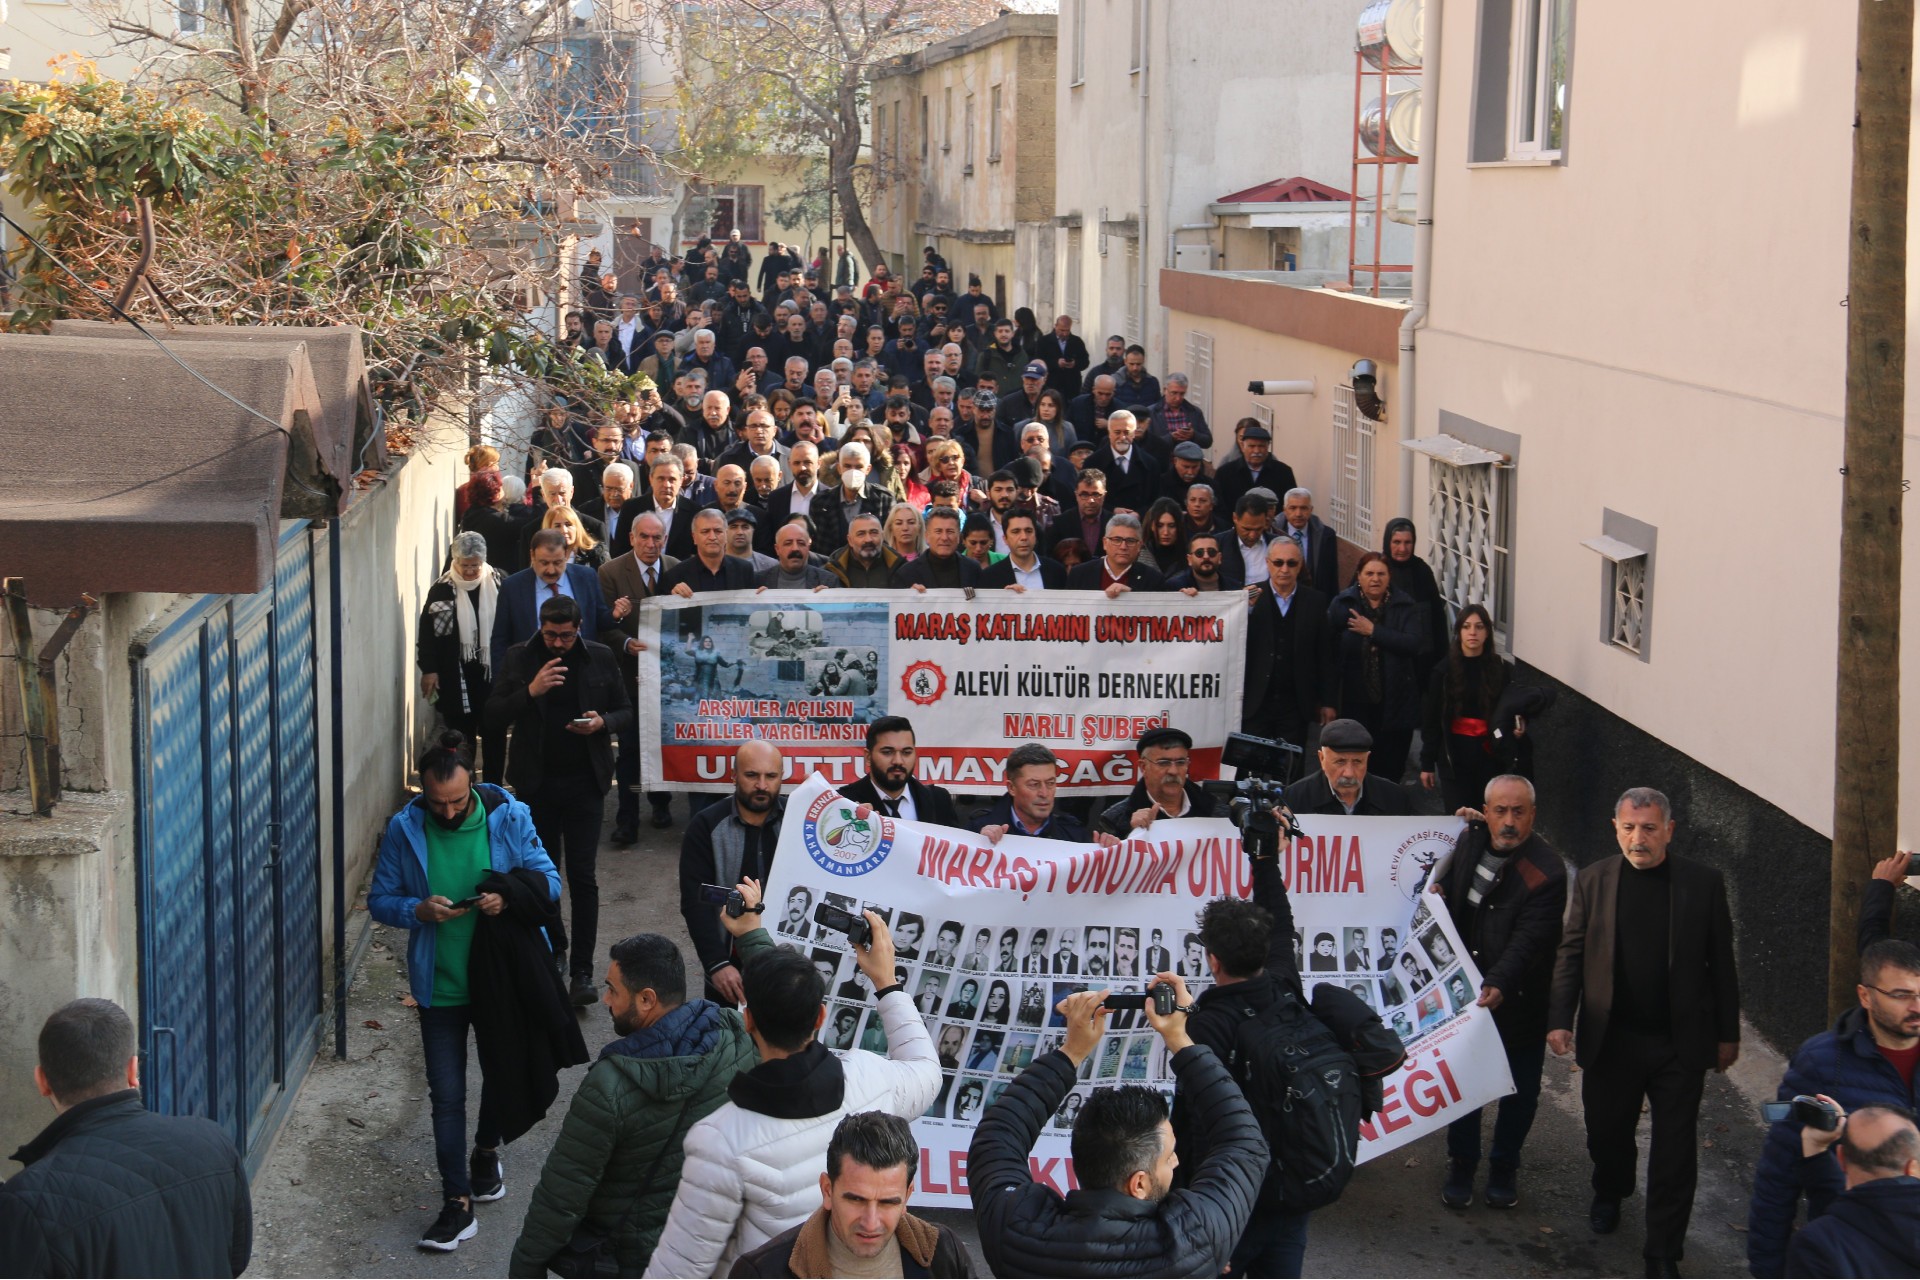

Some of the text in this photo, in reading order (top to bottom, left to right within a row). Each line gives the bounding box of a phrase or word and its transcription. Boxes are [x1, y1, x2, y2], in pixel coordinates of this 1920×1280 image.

[895, 613, 971, 644] MARAŞ
[1095, 615, 1224, 643] UNUTMADIK!
[954, 664, 1009, 696] ALEVİ
[1018, 665, 1090, 698] KÜLTÜR
[698, 696, 854, 721] ARŞİVLER AÇILSIN
[675, 719, 868, 741] KATİLLER YARGILANSIN
[1003, 712, 1075, 740] NARLI
[804, 823, 892, 875] KAHRAMANMARAŞ
[833, 849, 858, 860] 2007
[1066, 838, 1183, 894] UNUTMA
